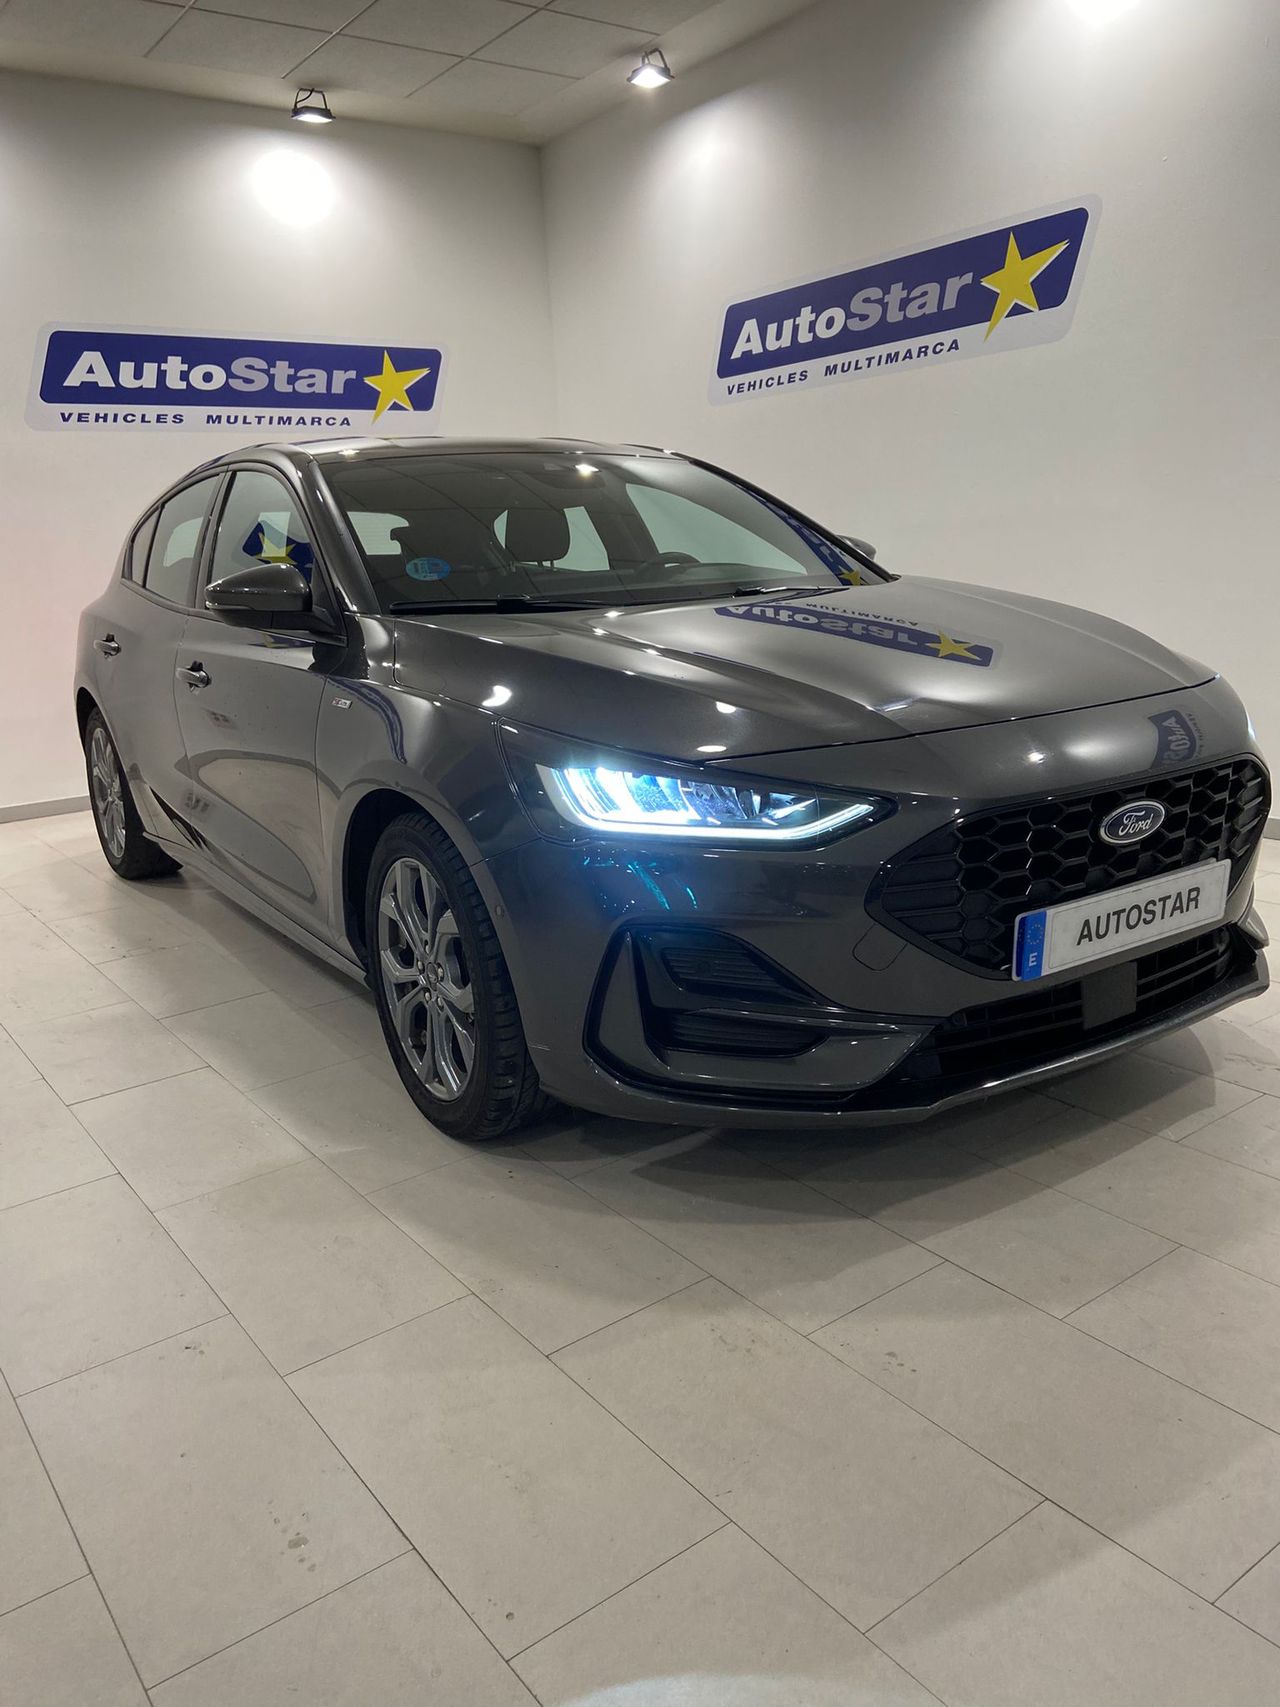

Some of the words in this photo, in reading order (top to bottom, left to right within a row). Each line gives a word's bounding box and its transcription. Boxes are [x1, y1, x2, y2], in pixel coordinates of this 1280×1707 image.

[730, 271, 974, 360] AutoStar
[63, 350, 356, 394] AutoStar
[726, 369, 809, 396] VEHICLES
[824, 338, 961, 377] MULTIMARCA
[60, 411, 185, 425] VEHICLES
[206, 414, 352, 427] MULTIMARCA
[1118, 810, 1154, 836] Ford
[1028, 952, 1037, 967] E
[1076, 886, 1201, 946] AUTOSTAR
